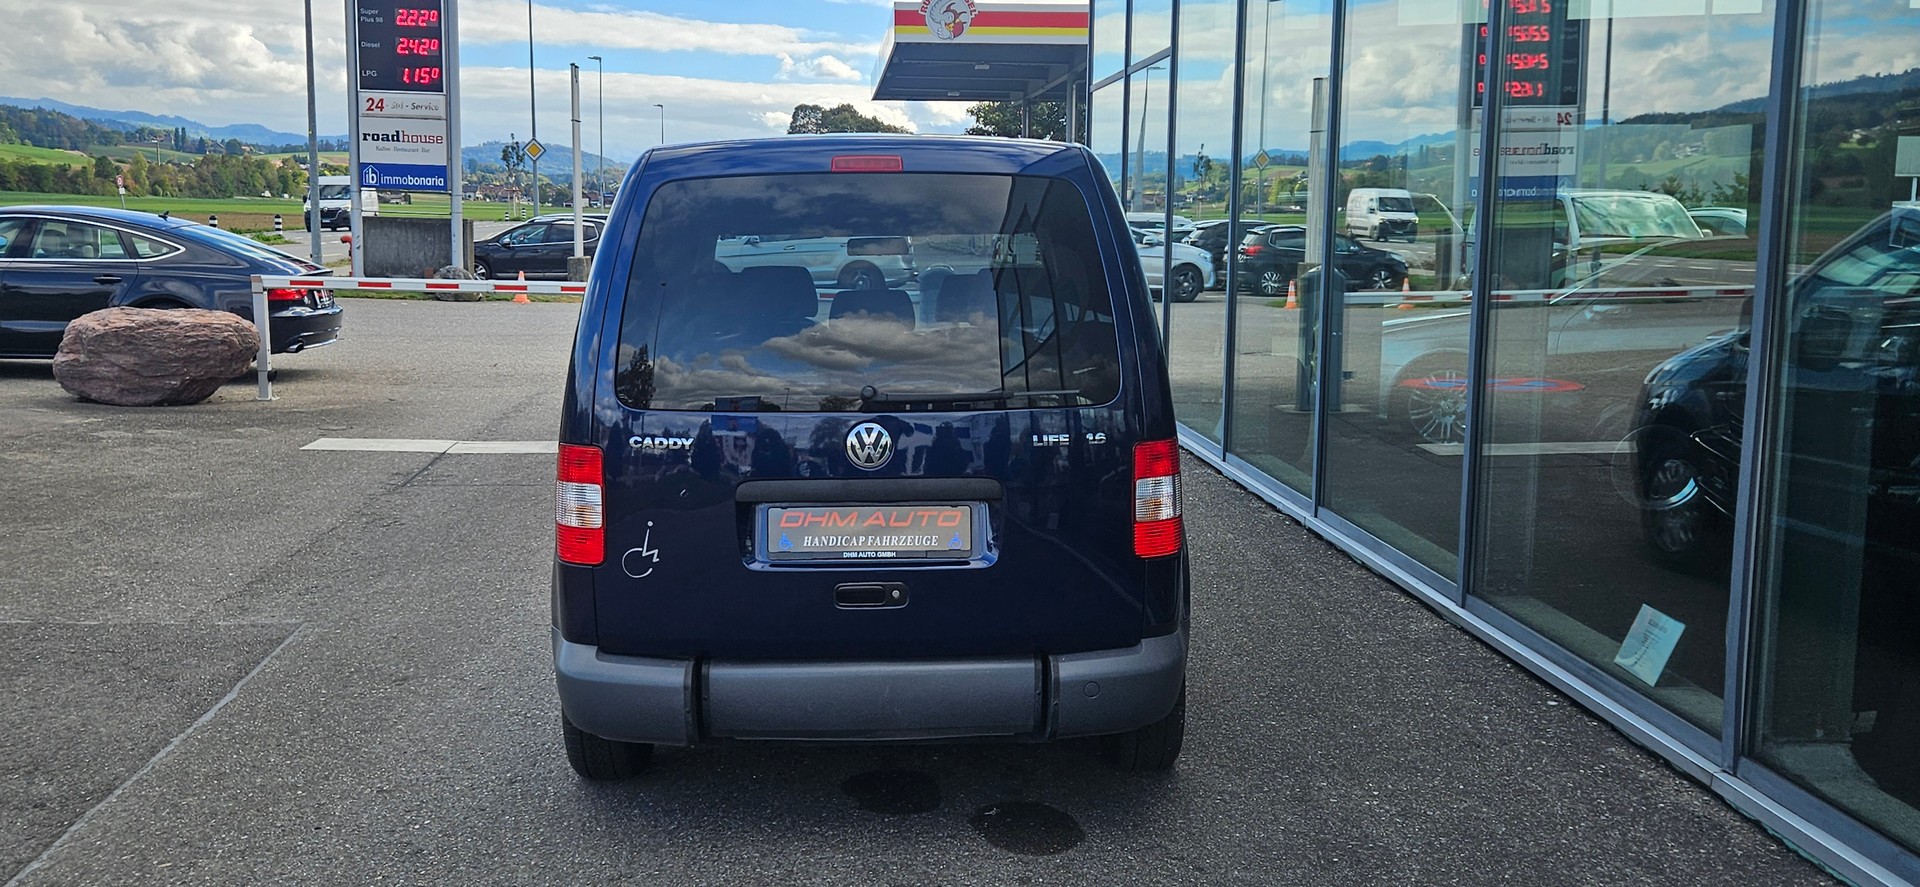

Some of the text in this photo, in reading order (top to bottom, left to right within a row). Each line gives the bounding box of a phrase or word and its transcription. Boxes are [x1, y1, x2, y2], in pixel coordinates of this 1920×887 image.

[365, 97, 385, 112] 24
[362, 130, 444, 145] roadhouse
[380, 174, 445, 186] immobonaria
[629, 436, 694, 449] CADDY
[1032, 433, 1070, 447] LIFE
[779, 510, 962, 528] DHM AUTO
[803, 535, 939, 547] HANDICAP FAHRZEUGE
